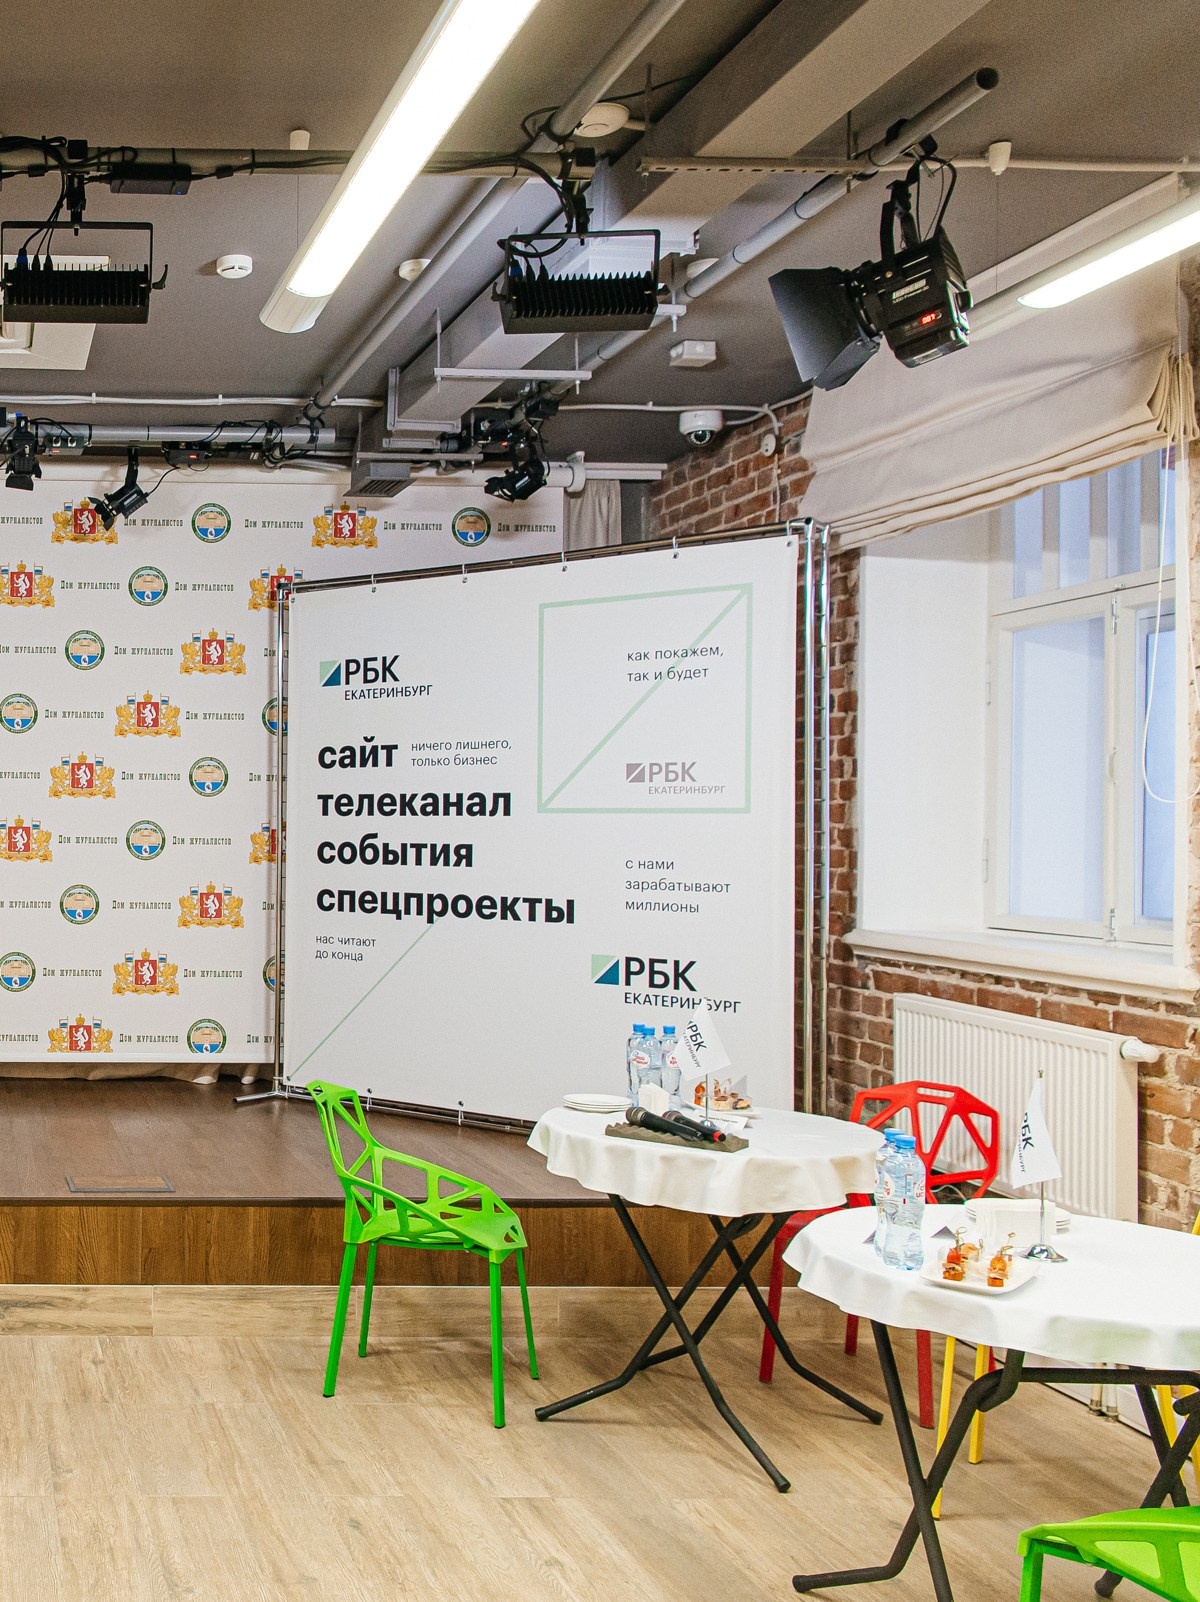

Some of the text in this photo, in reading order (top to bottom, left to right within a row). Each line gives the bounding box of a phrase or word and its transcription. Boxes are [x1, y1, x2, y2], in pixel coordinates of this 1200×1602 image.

[627, 646, 724, 662] как покажем,
[345, 655, 400, 685] РБК
[627, 666, 709, 682] так и будет
[345, 685, 433, 701] ЕКАТЕРИНБУРГ
[317, 736, 399, 769] сайт
[411, 740, 512, 752] ничего лишнего,
[411, 754, 498, 767] только бизнес
[648, 762, 697, 783] РБК
[648, 785, 727, 795] ЕКАТЕРИНБУРГ
[316, 792, 512, 817] телеканал
[316, 833, 474, 867] события
[625, 860, 675, 871] с нами
[625, 877, 731, 894] зарабатывают
[316, 889, 575, 925] спецпроекты
[625, 900, 700, 914] миллионы
[315, 935, 377, 948] нас читают
[315, 950, 364, 962] до конца
[625, 957, 697, 993] РБК
[625, 992, 741, 1013] ЕКАТЕРИНБУРГ
[687, 1023, 707, 1052] РБК
